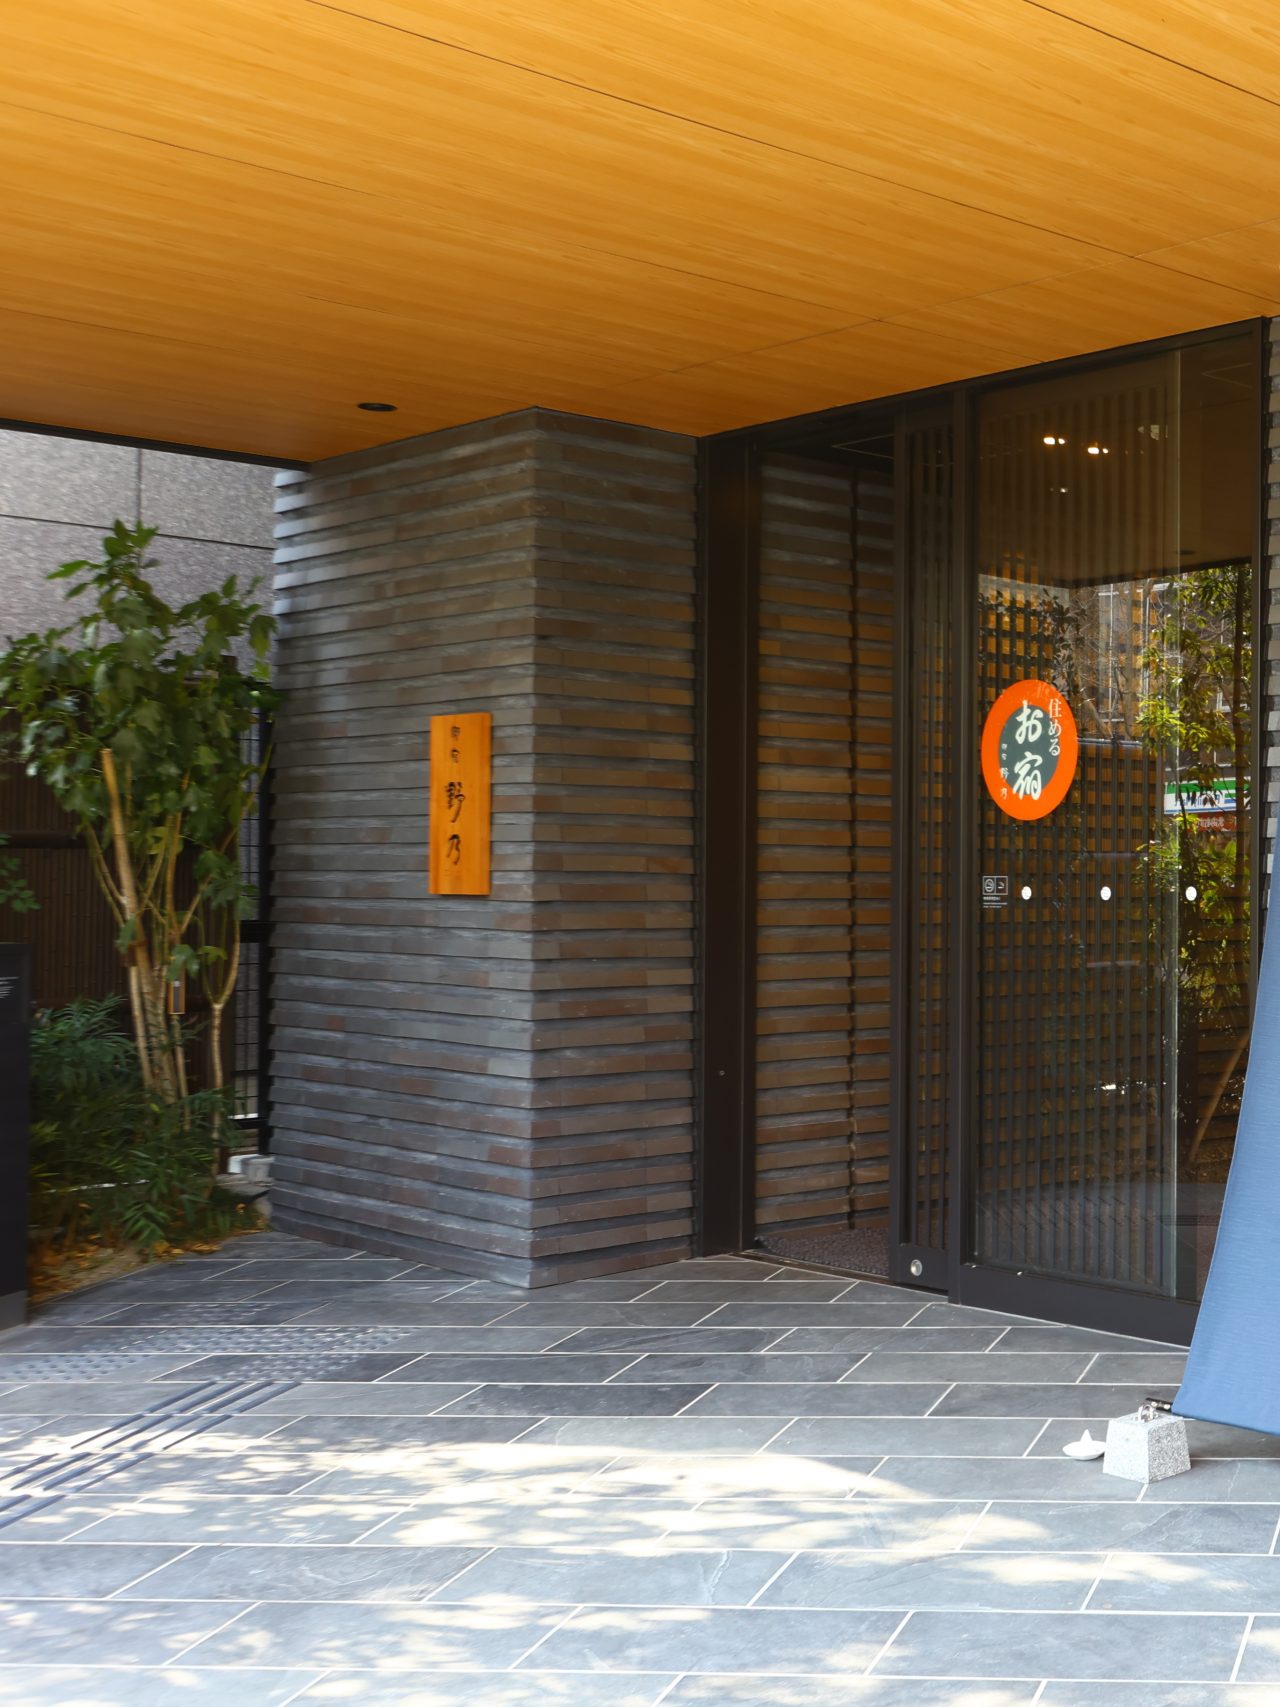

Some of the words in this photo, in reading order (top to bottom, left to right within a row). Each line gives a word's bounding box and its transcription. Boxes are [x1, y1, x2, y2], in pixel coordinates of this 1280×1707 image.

[1013, 699, 1043, 801] お宿
[1047, 698, 1063, 756] 住める
